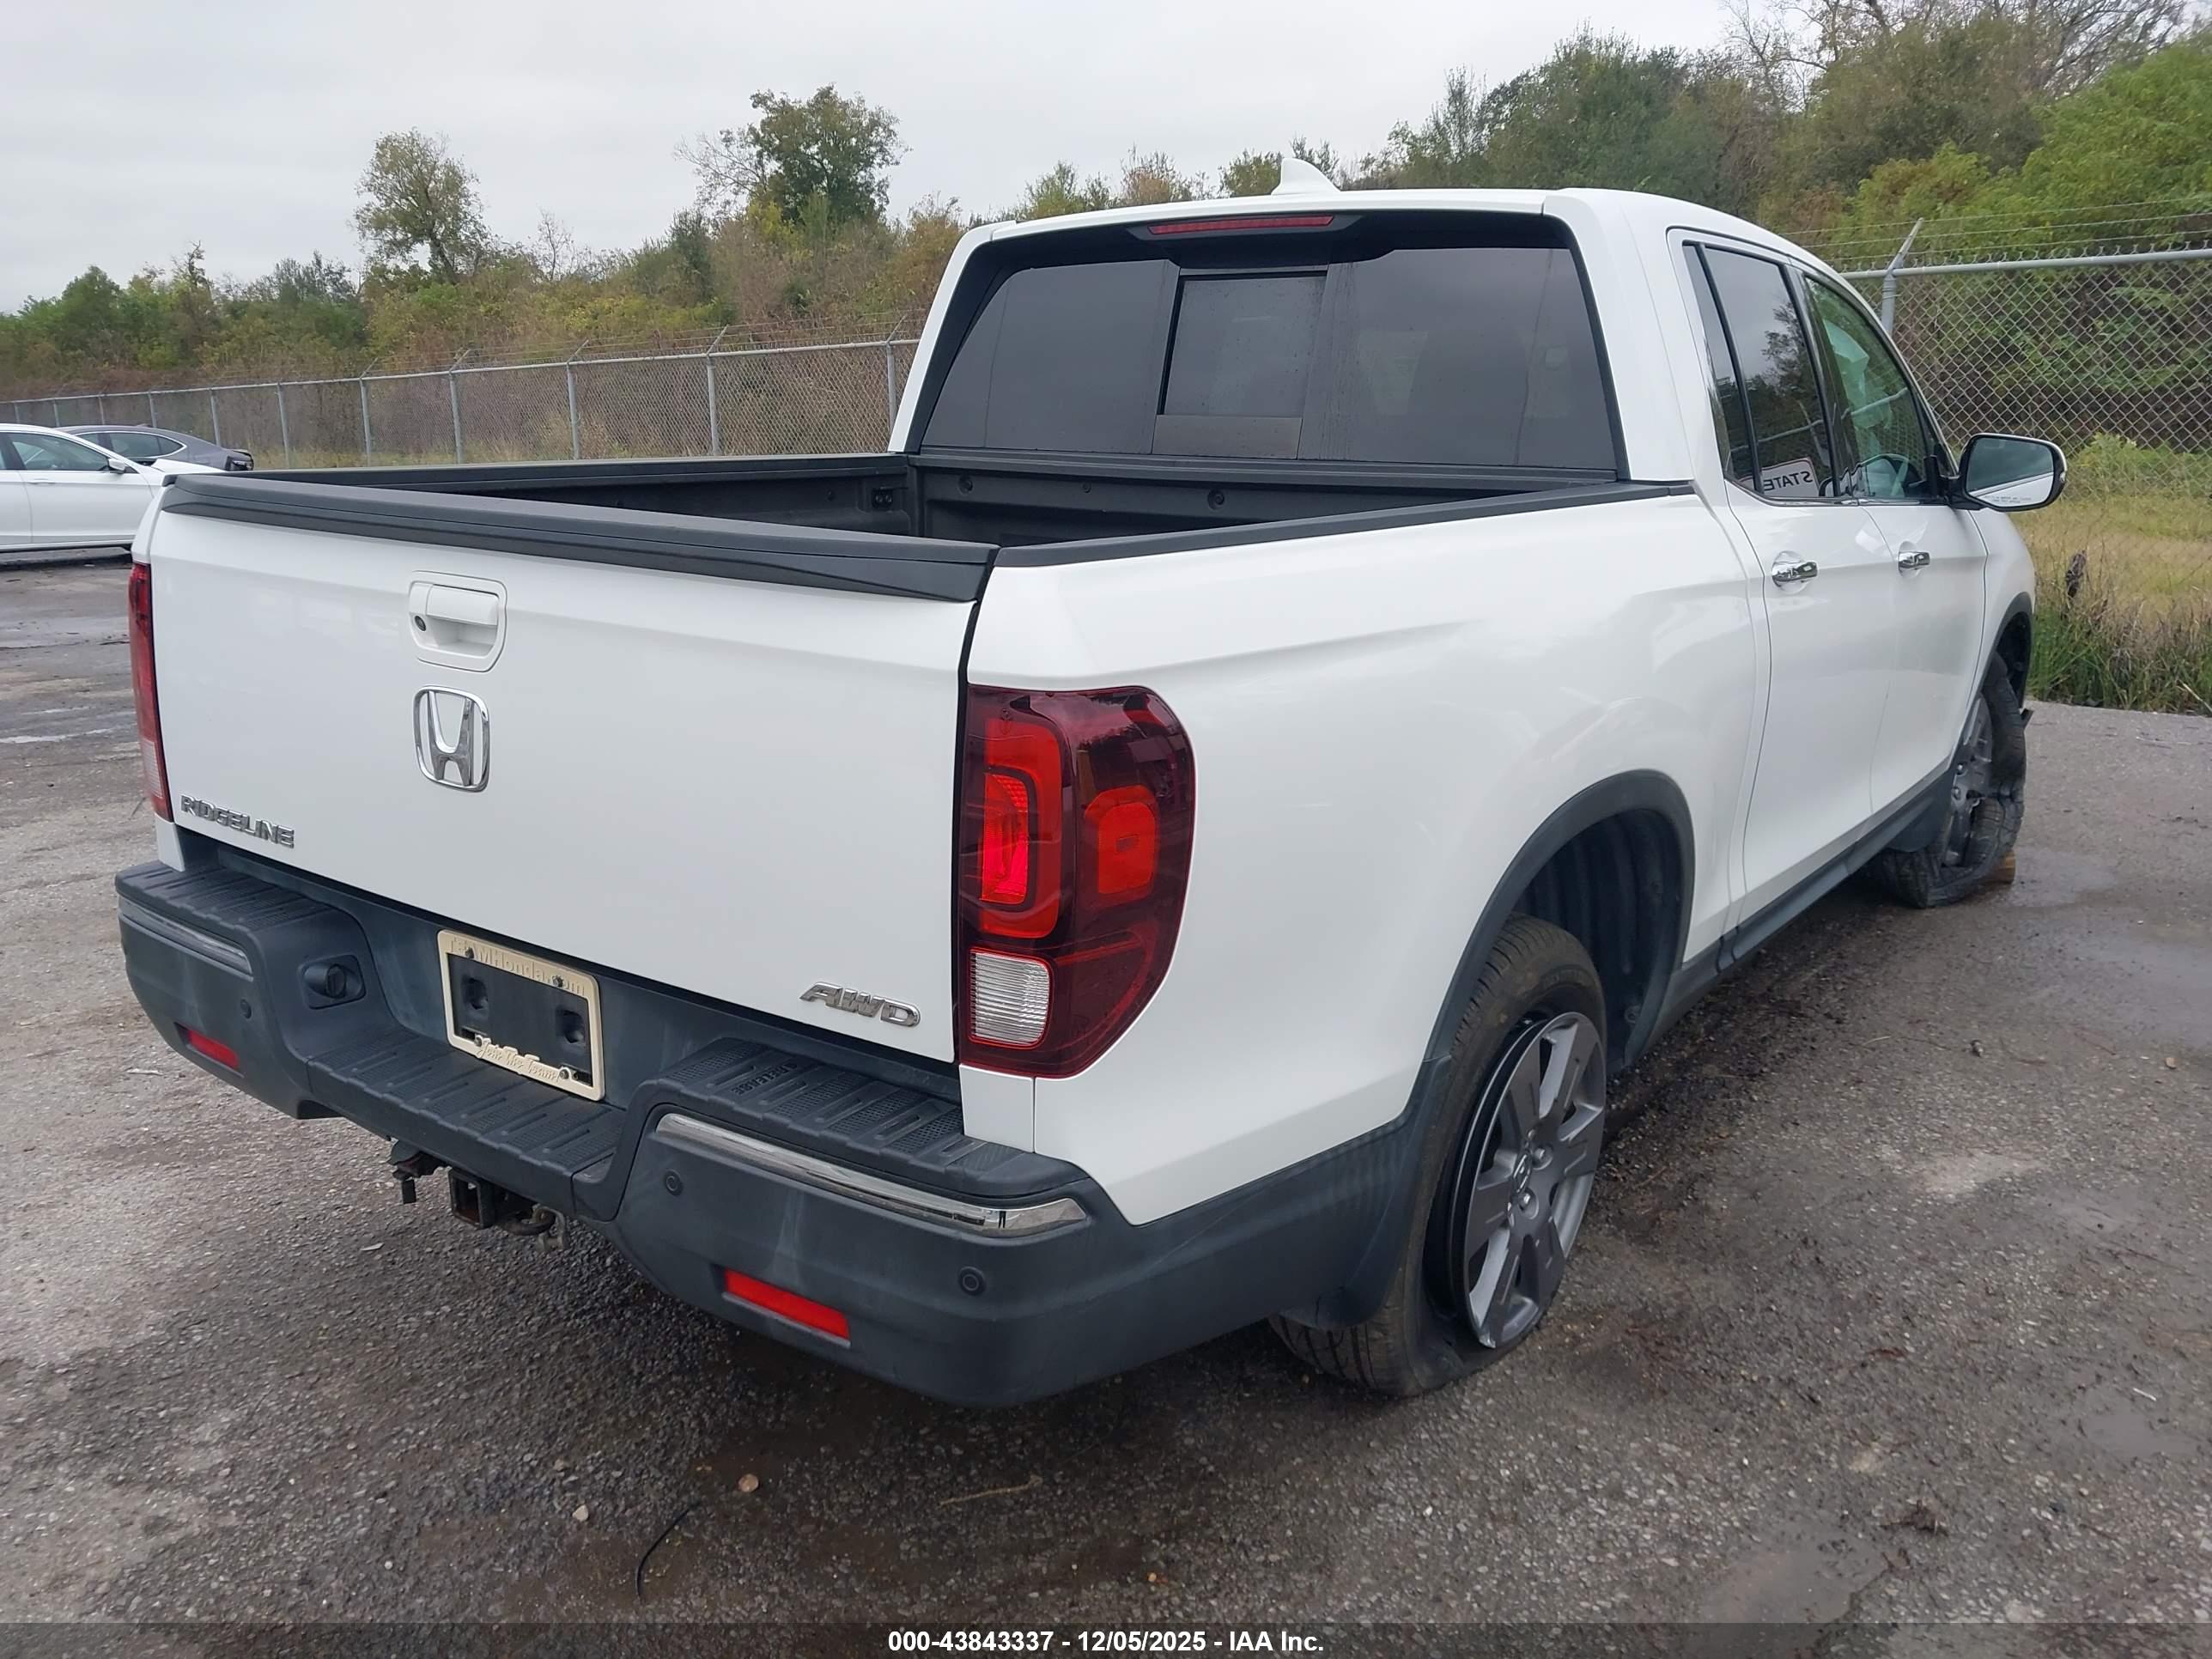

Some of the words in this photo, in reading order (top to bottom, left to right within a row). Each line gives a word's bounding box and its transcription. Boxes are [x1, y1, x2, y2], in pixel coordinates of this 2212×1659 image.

[180, 793, 295, 849] RIDGELINE
[447, 936, 586, 998] TEAMHonda.om
[799, 981, 921, 1028] AWD
